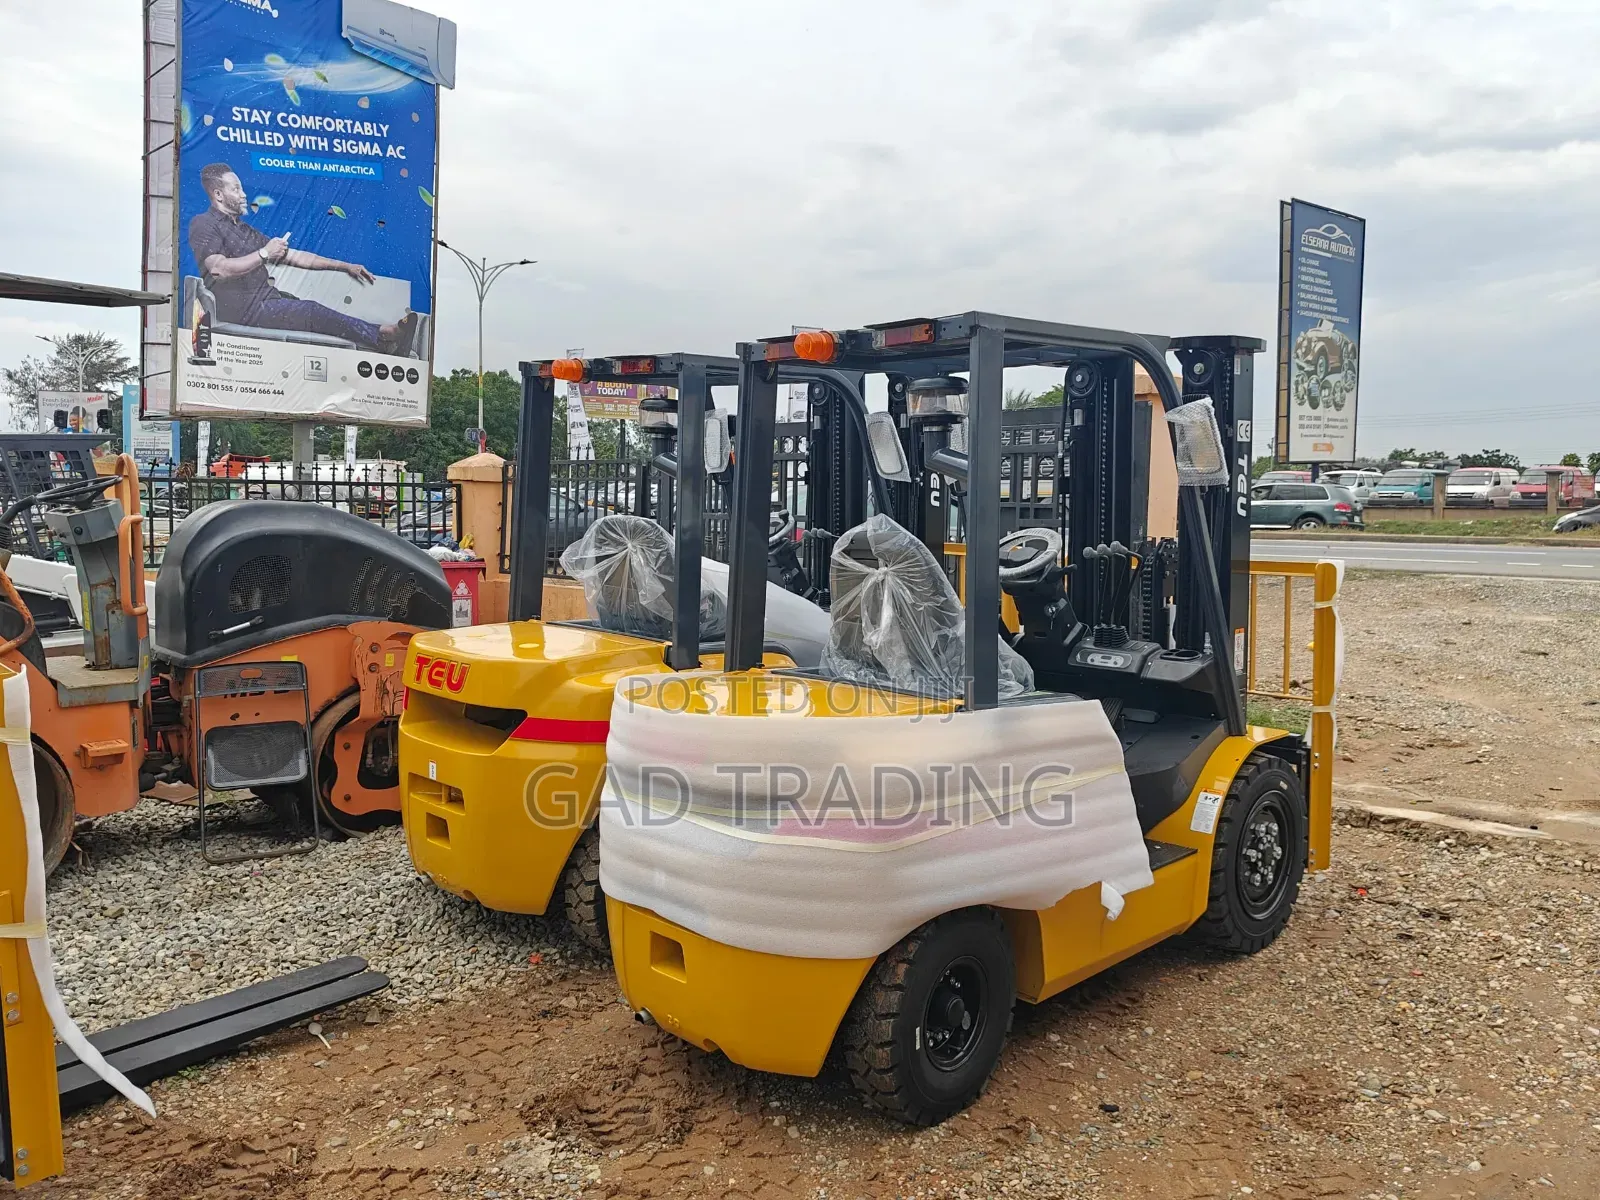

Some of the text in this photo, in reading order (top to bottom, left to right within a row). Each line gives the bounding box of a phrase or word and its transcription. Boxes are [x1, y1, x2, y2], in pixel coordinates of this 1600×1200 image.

[231, 106, 390, 138] STAY COMFORTABLY
[216, 125, 407, 160] CHILLED WITH SIGMA AC
[259, 157, 375, 176] COOLER THAN ANTARCTICA
[226, 342, 260, 352] Conditioner
[235, 350, 262, 360] Company
[310, 360, 322, 371] 12
[186, 380, 206, 389] 0302
[206, 382, 220, 391] 801
[220, 384, 234, 392] 555
[240, 386, 257, 395] 0554
[258, 388, 271, 396] 666
[272, 388, 285, 396] 444
[597, 387, 627, 396] TODAY!
[930, 472, 940, 507] EU
[1237, 453, 1249, 518] TEU
[414, 652, 471, 694] TEU
